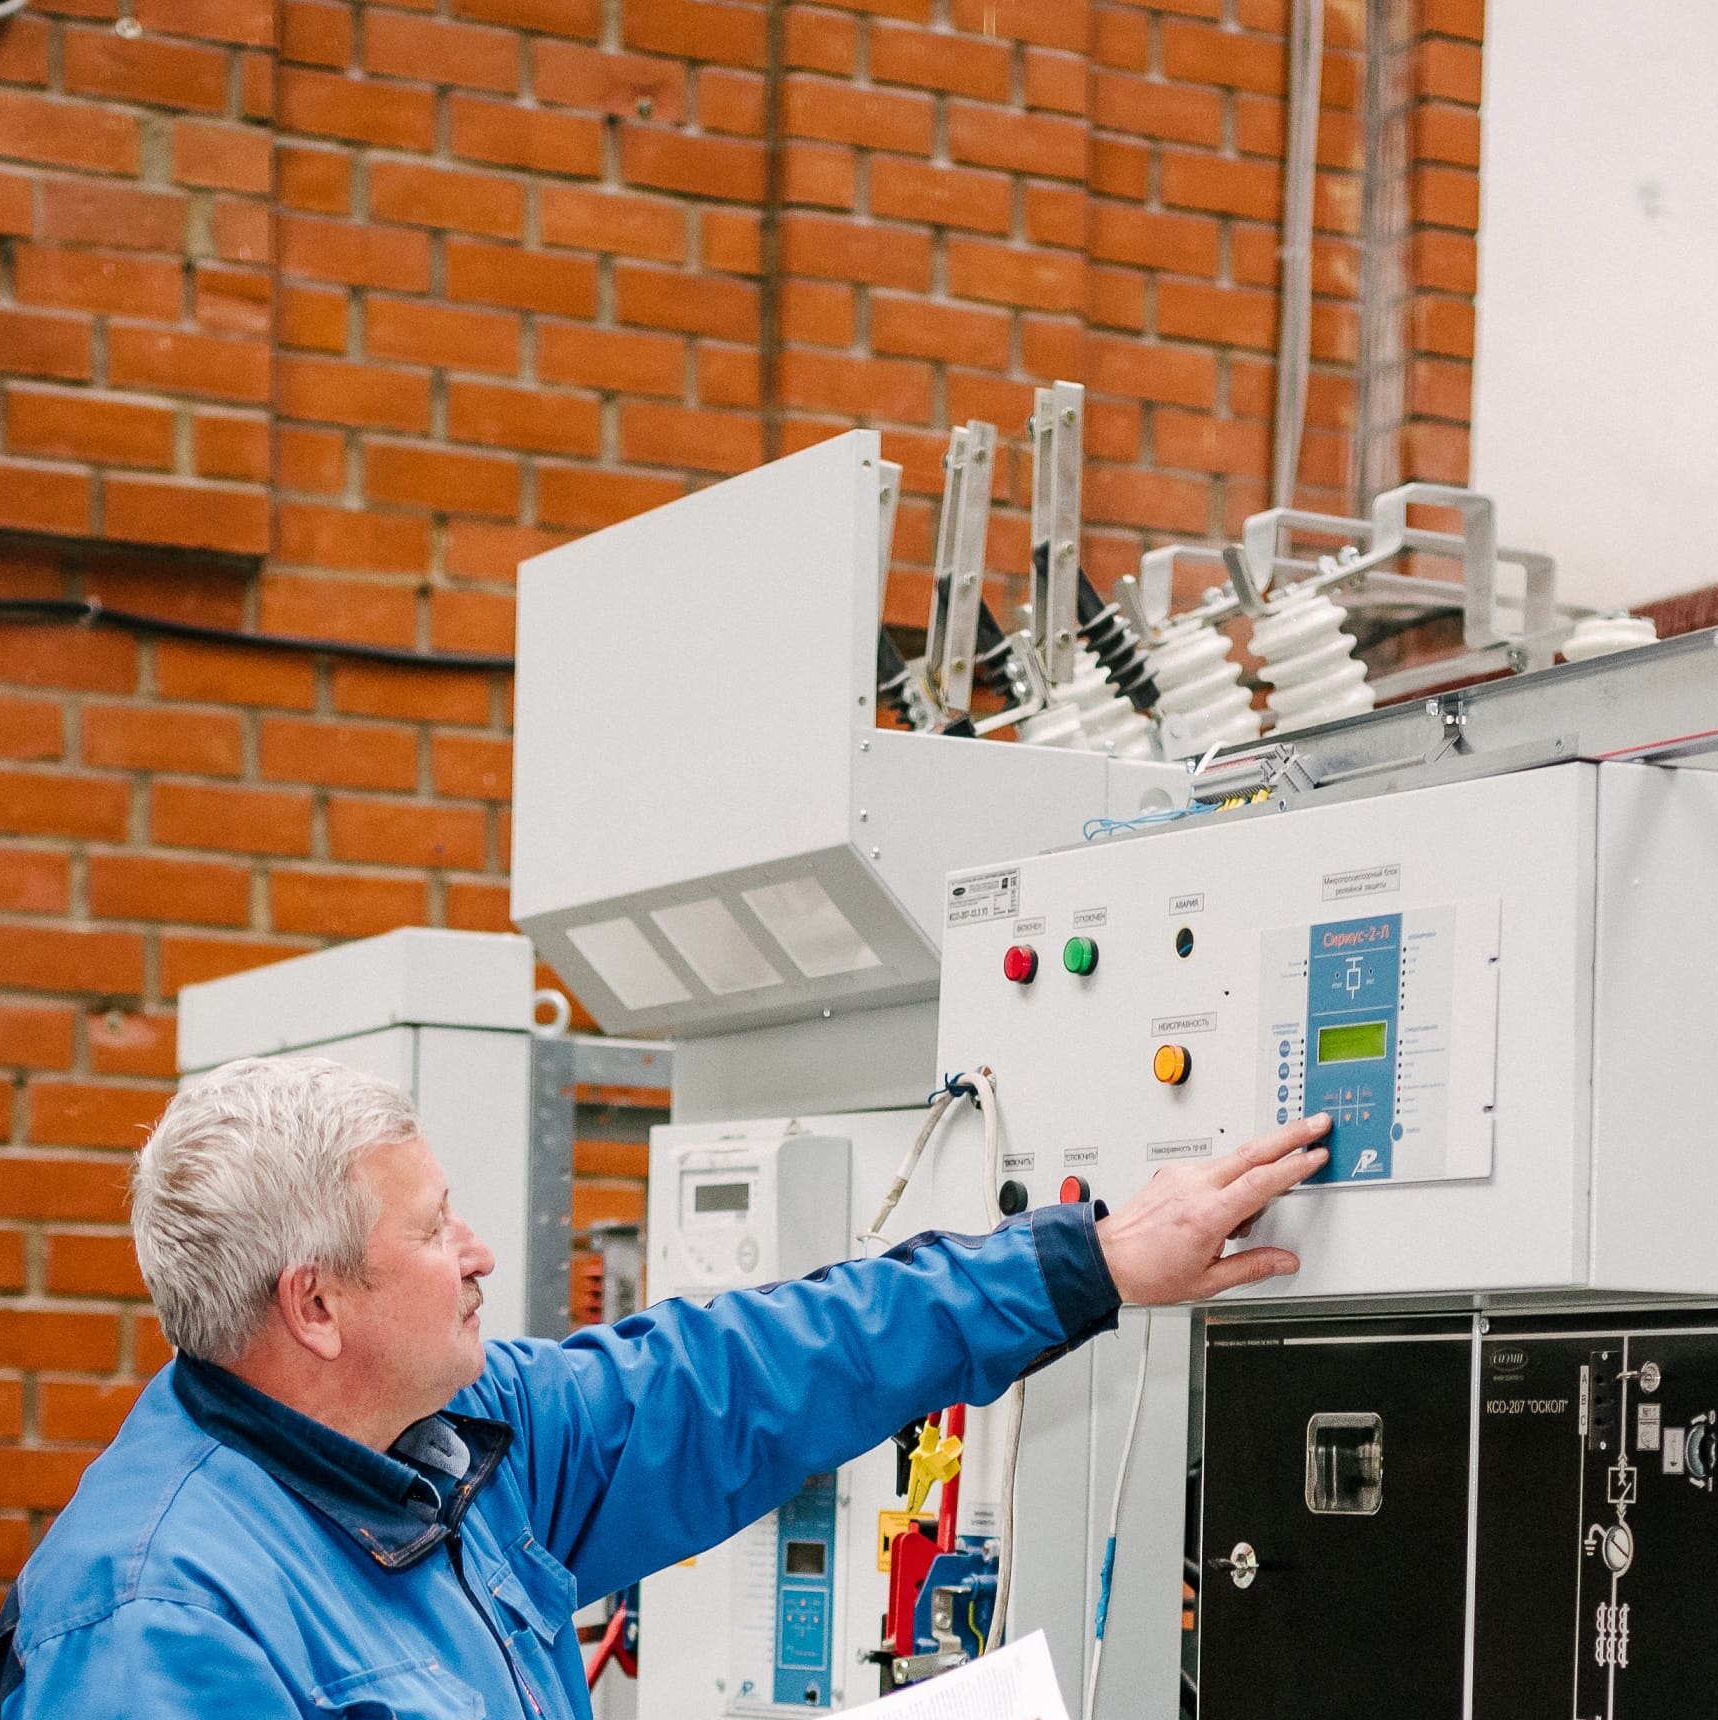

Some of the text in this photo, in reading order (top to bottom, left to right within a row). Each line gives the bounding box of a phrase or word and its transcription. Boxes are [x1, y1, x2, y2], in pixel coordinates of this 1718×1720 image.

[1175, 899, 1199, 910] АВАРИЯ
[1323, 924, 1390, 948] Сириус-2-Л
[1158, 1018, 1210, 1031] НЕИСПРАВНОСТЬ
[1486, 1399, 1569, 1414] КСО-207 "ОСКОЛ"
